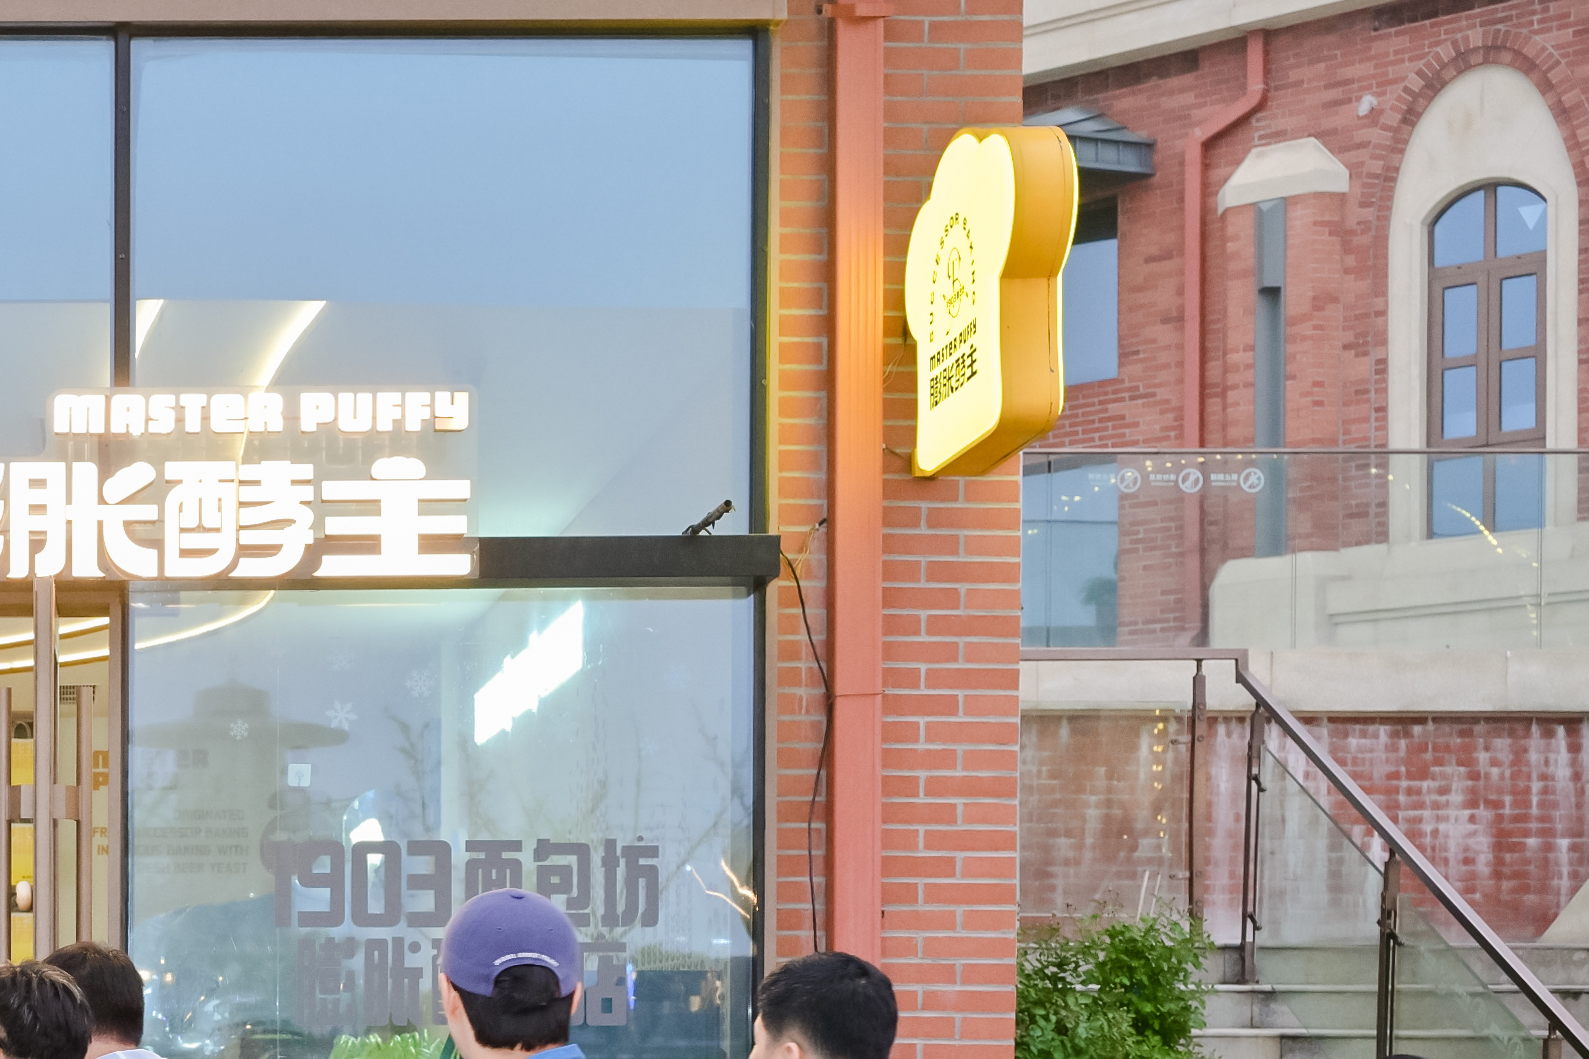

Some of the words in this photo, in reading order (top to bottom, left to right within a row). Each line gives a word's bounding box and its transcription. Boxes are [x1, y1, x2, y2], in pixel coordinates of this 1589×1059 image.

[930, 338, 957, 372] MASTER
[959, 317, 977, 344] PUFFY
[930, 343, 978, 411] 膨胀酵主
[299, 391, 469, 434] PUFFY
